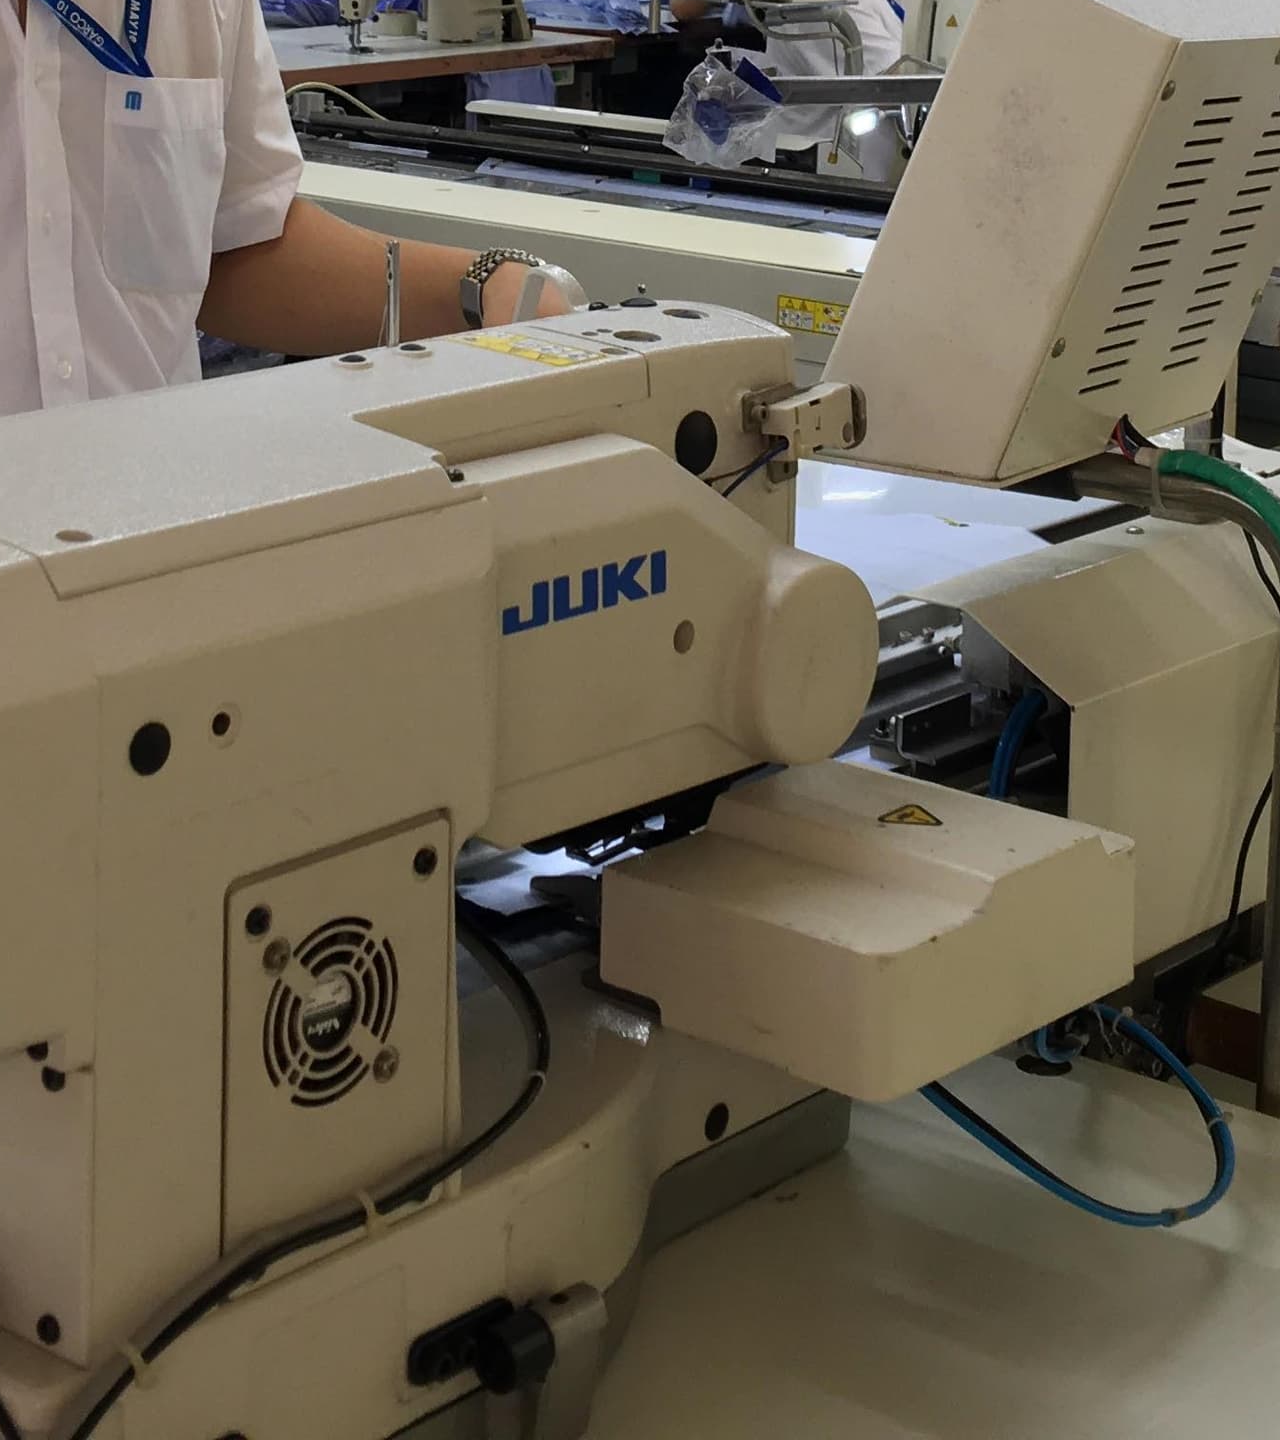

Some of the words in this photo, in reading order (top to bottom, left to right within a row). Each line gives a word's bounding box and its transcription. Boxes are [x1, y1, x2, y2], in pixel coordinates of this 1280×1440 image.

[56, 0, 70, 16] 10
[129, 1, 141, 29] MAY
[70, 13, 105, 48] GARCO
[502, 550, 667, 635] JUKI
